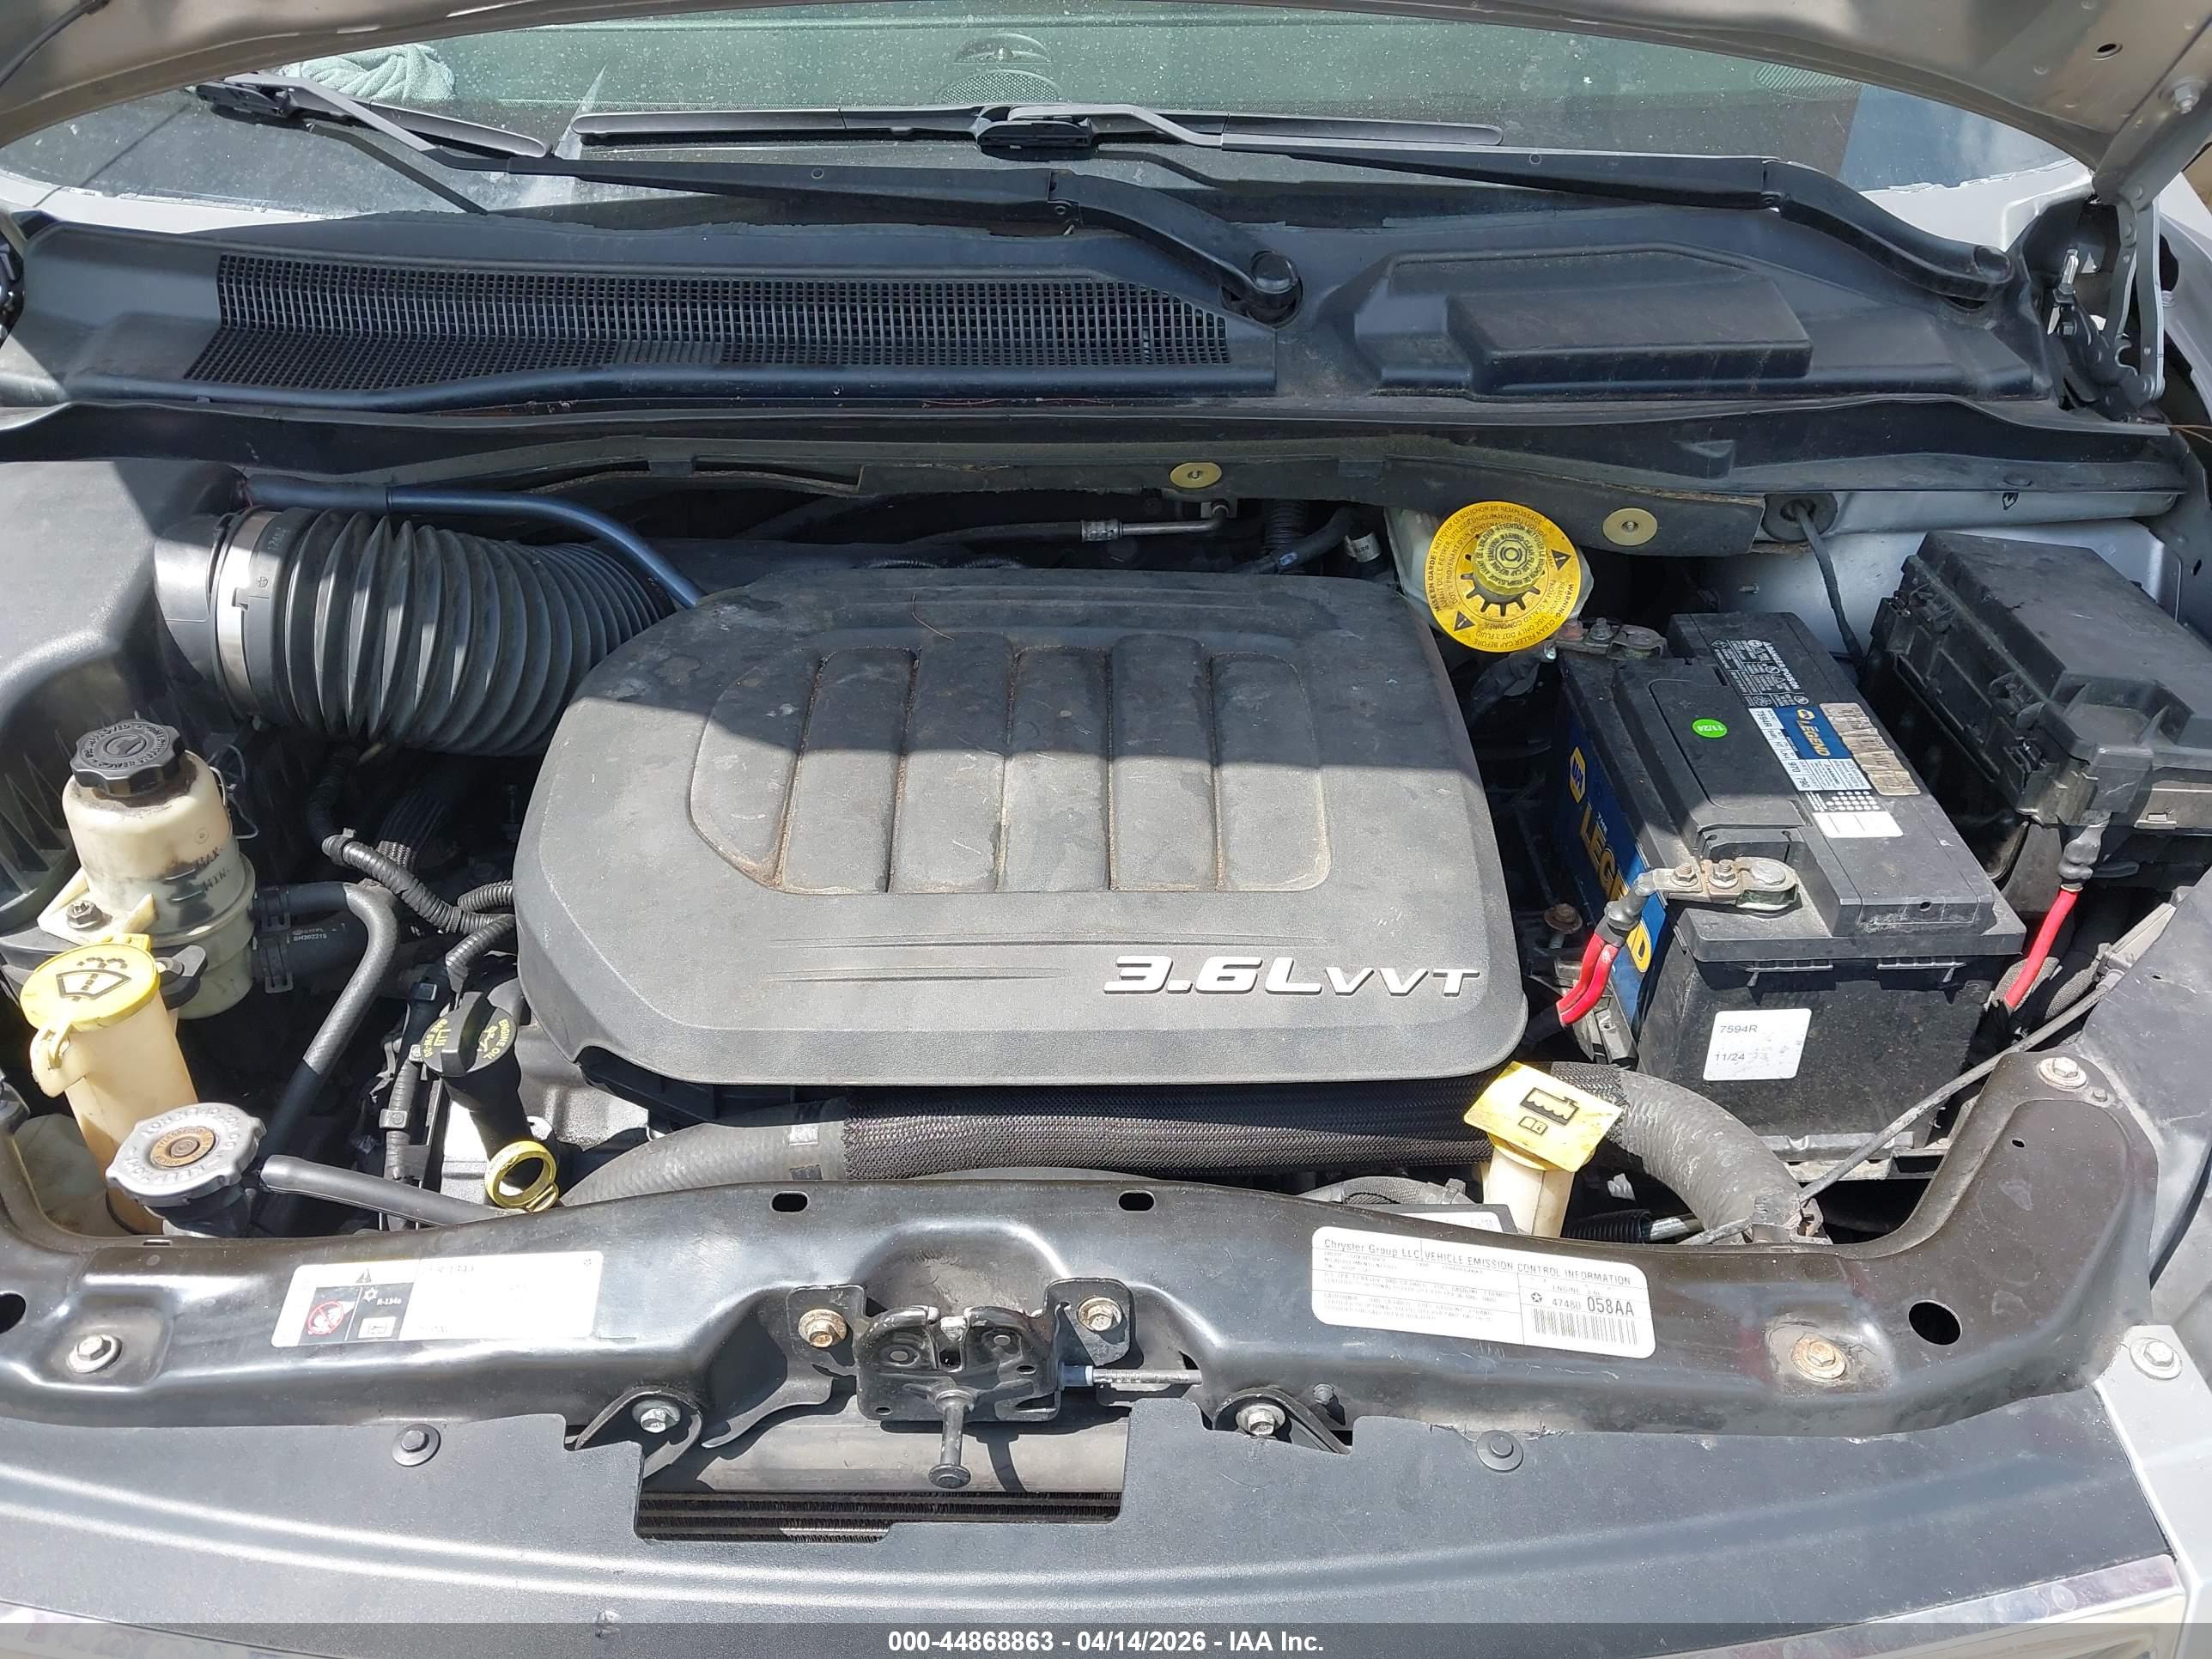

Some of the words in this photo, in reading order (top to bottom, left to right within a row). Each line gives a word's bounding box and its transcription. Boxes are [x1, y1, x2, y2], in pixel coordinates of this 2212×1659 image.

[1460, 505, 1489, 520] BOUCHON
[1434, 521, 1454, 550] NETTOYER
[1428, 555, 1437, 581] GARDE
[1446, 544, 1460, 584] PROVENANT
[1428, 583, 1435, 593] EN
[1536, 619, 1556, 636] CLEAN
[1796, 720, 1831, 757] LEGEND
[1788, 762, 1801, 773] 970
[1796, 777, 1810, 788] 790
[497, 1018, 511, 1048] ENGINE
[1719, 1024, 1759, 1034] 7594R
[483, 1048, 501, 1060] OIL
[1714, 1053, 1745, 1061] 11/24
[1401, 1248, 1420, 1259] LLC
[1425, 1250, 1463, 1265] VEHICLE
[1467, 1256, 1514, 1271] EMISSION
[1517, 1263, 1561, 1278] CONTROL
[1565, 1269, 1632, 1285] INFORMATION
[1586, 1296, 1636, 1316] 058AA
